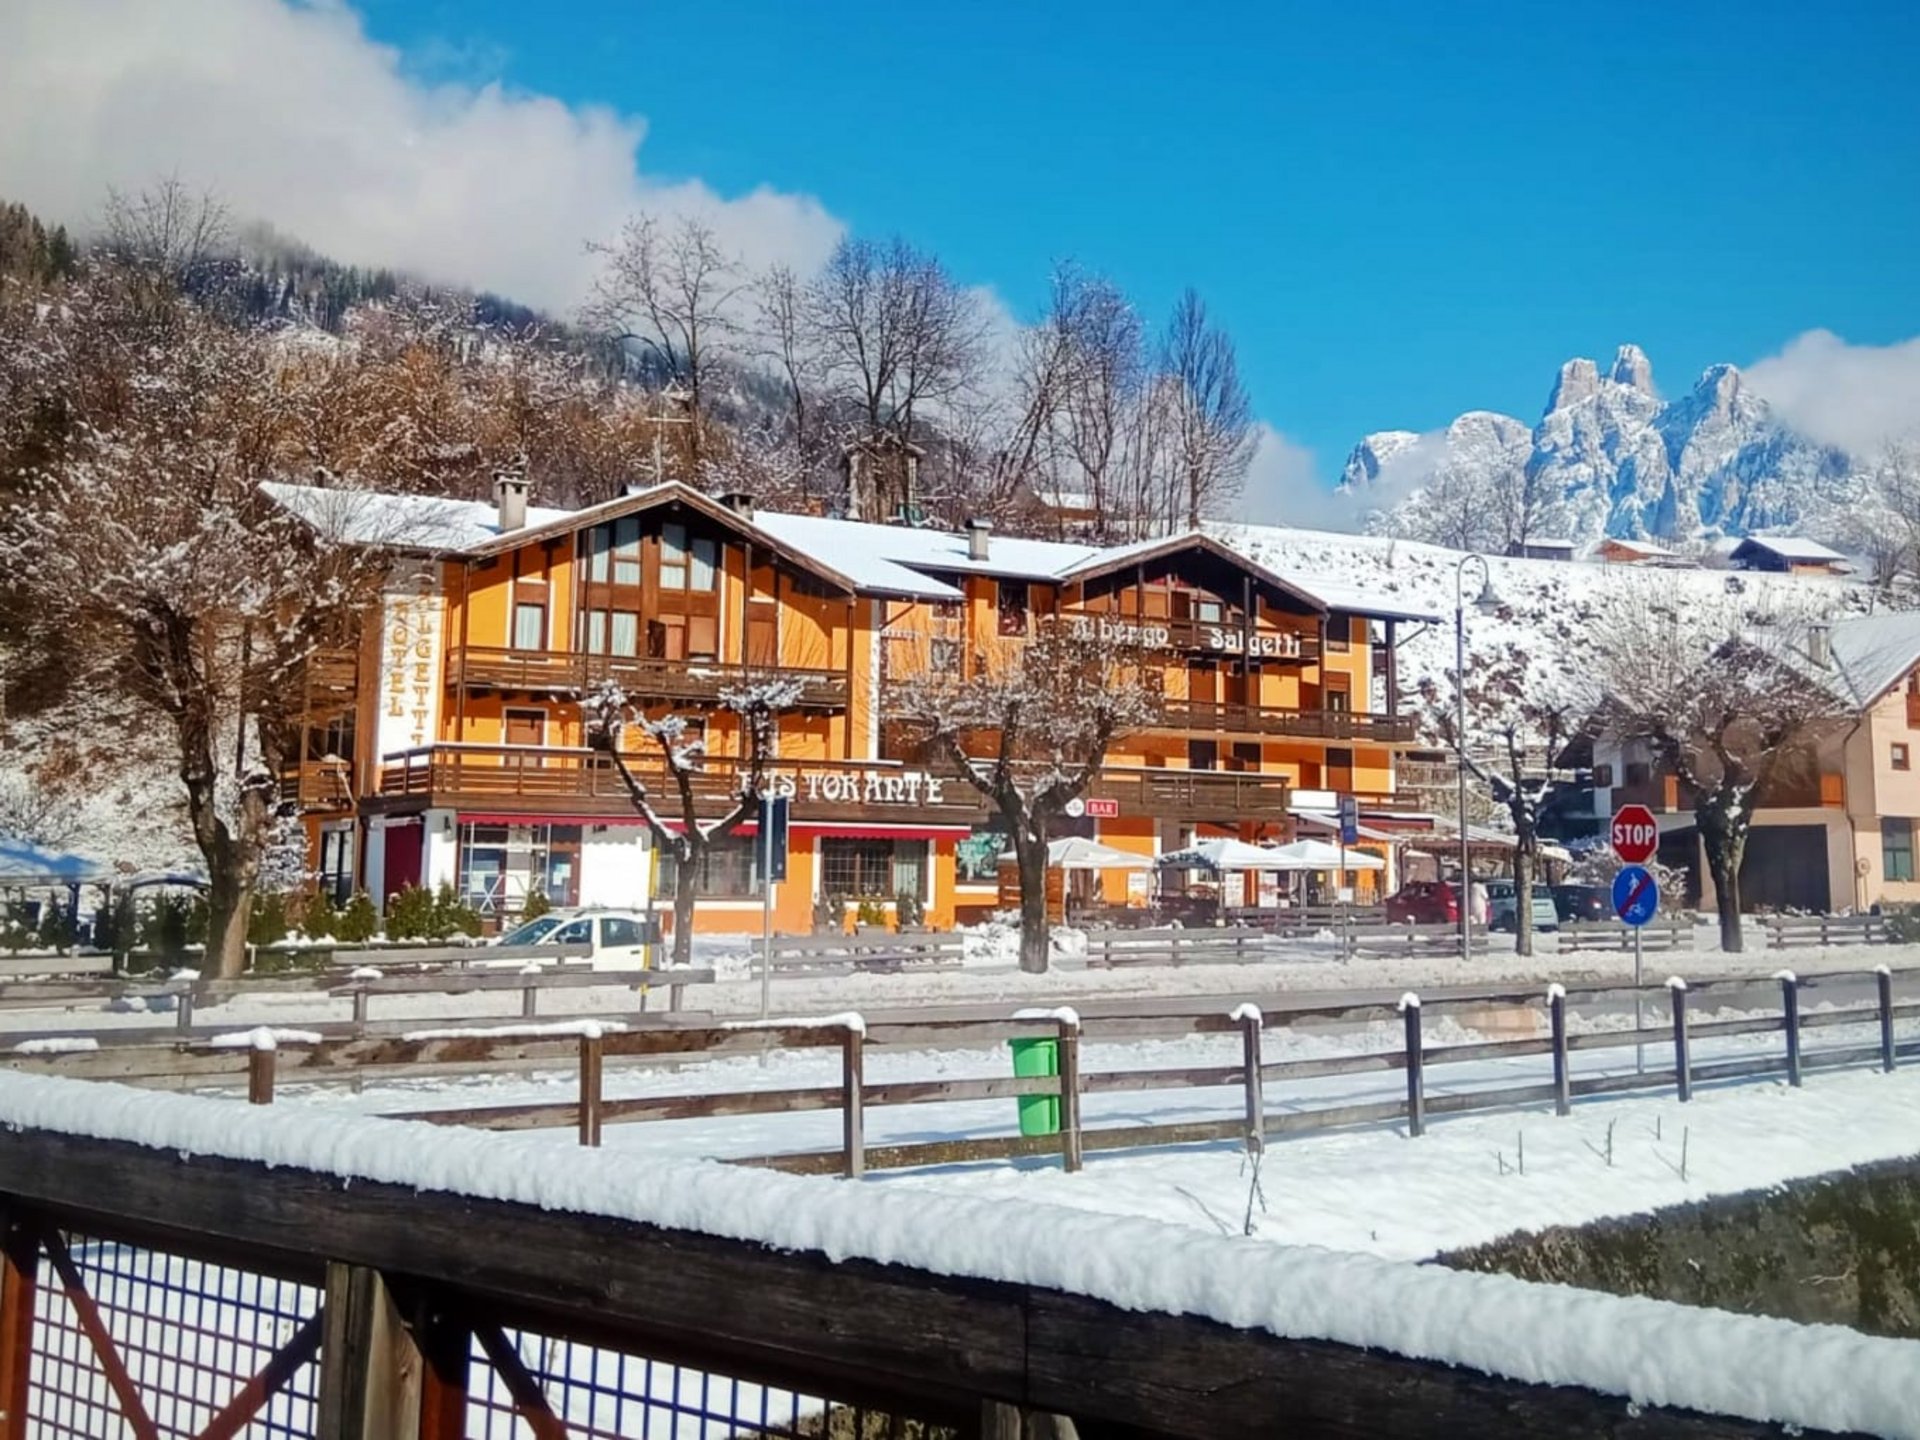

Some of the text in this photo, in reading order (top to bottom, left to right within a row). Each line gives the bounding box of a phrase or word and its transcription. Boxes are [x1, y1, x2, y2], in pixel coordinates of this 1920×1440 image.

[1210, 628, 1301, 656] Salgetti
[1091, 803, 1113, 814] BAR
[1615, 825, 1654, 845] STOP
